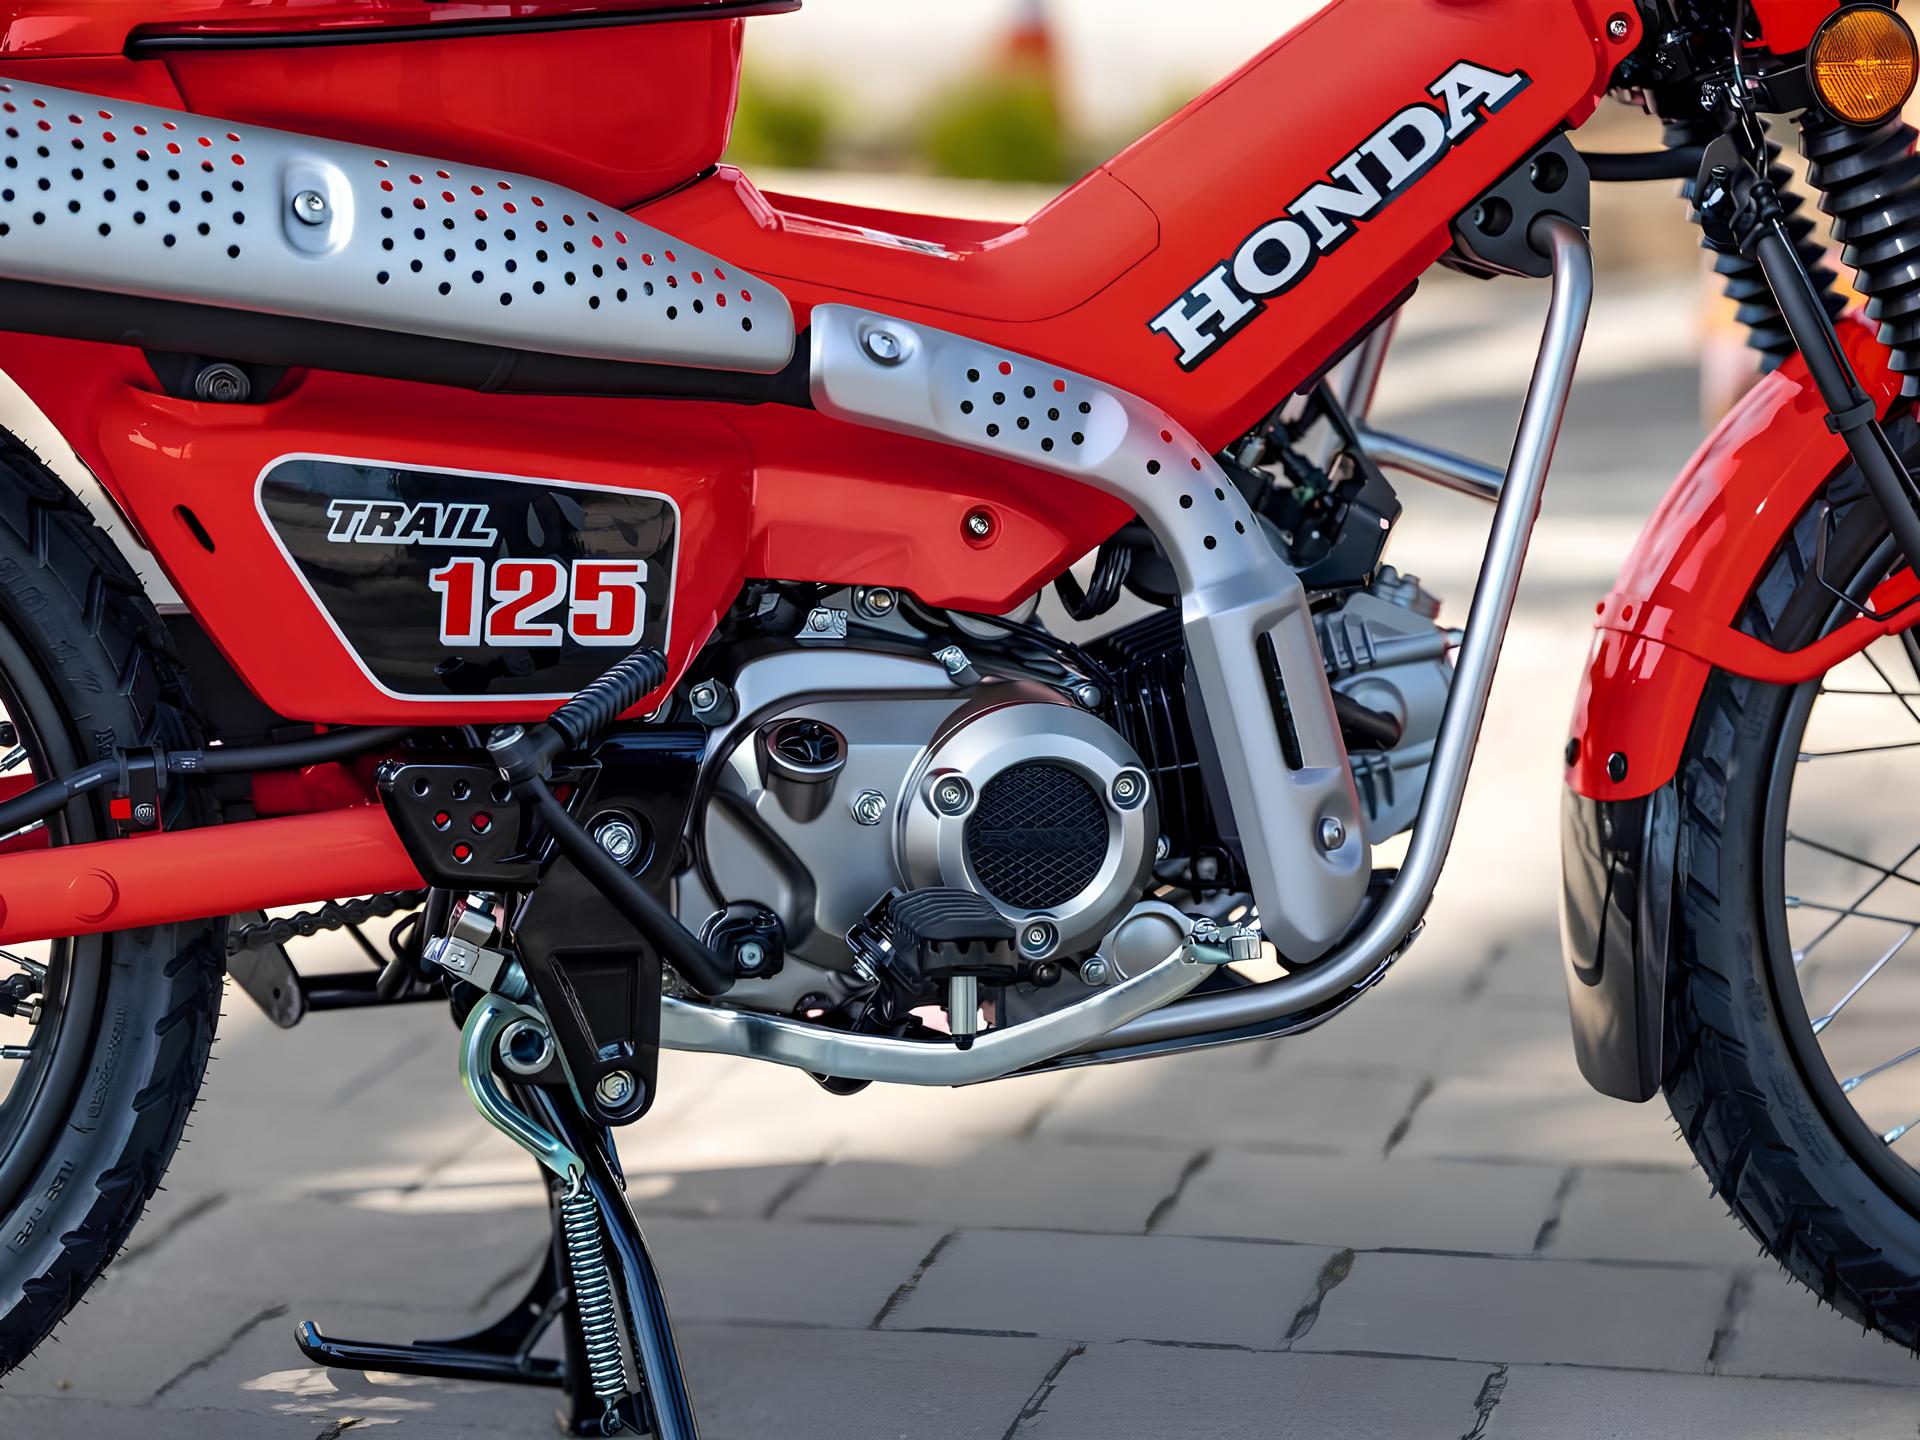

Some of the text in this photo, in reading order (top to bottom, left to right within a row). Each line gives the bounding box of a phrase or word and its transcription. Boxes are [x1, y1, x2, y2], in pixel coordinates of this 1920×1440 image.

[1147, 60, 1530, 371] HONDA
[326, 498, 499, 547] TRAIL
[427, 556, 649, 647] 125
